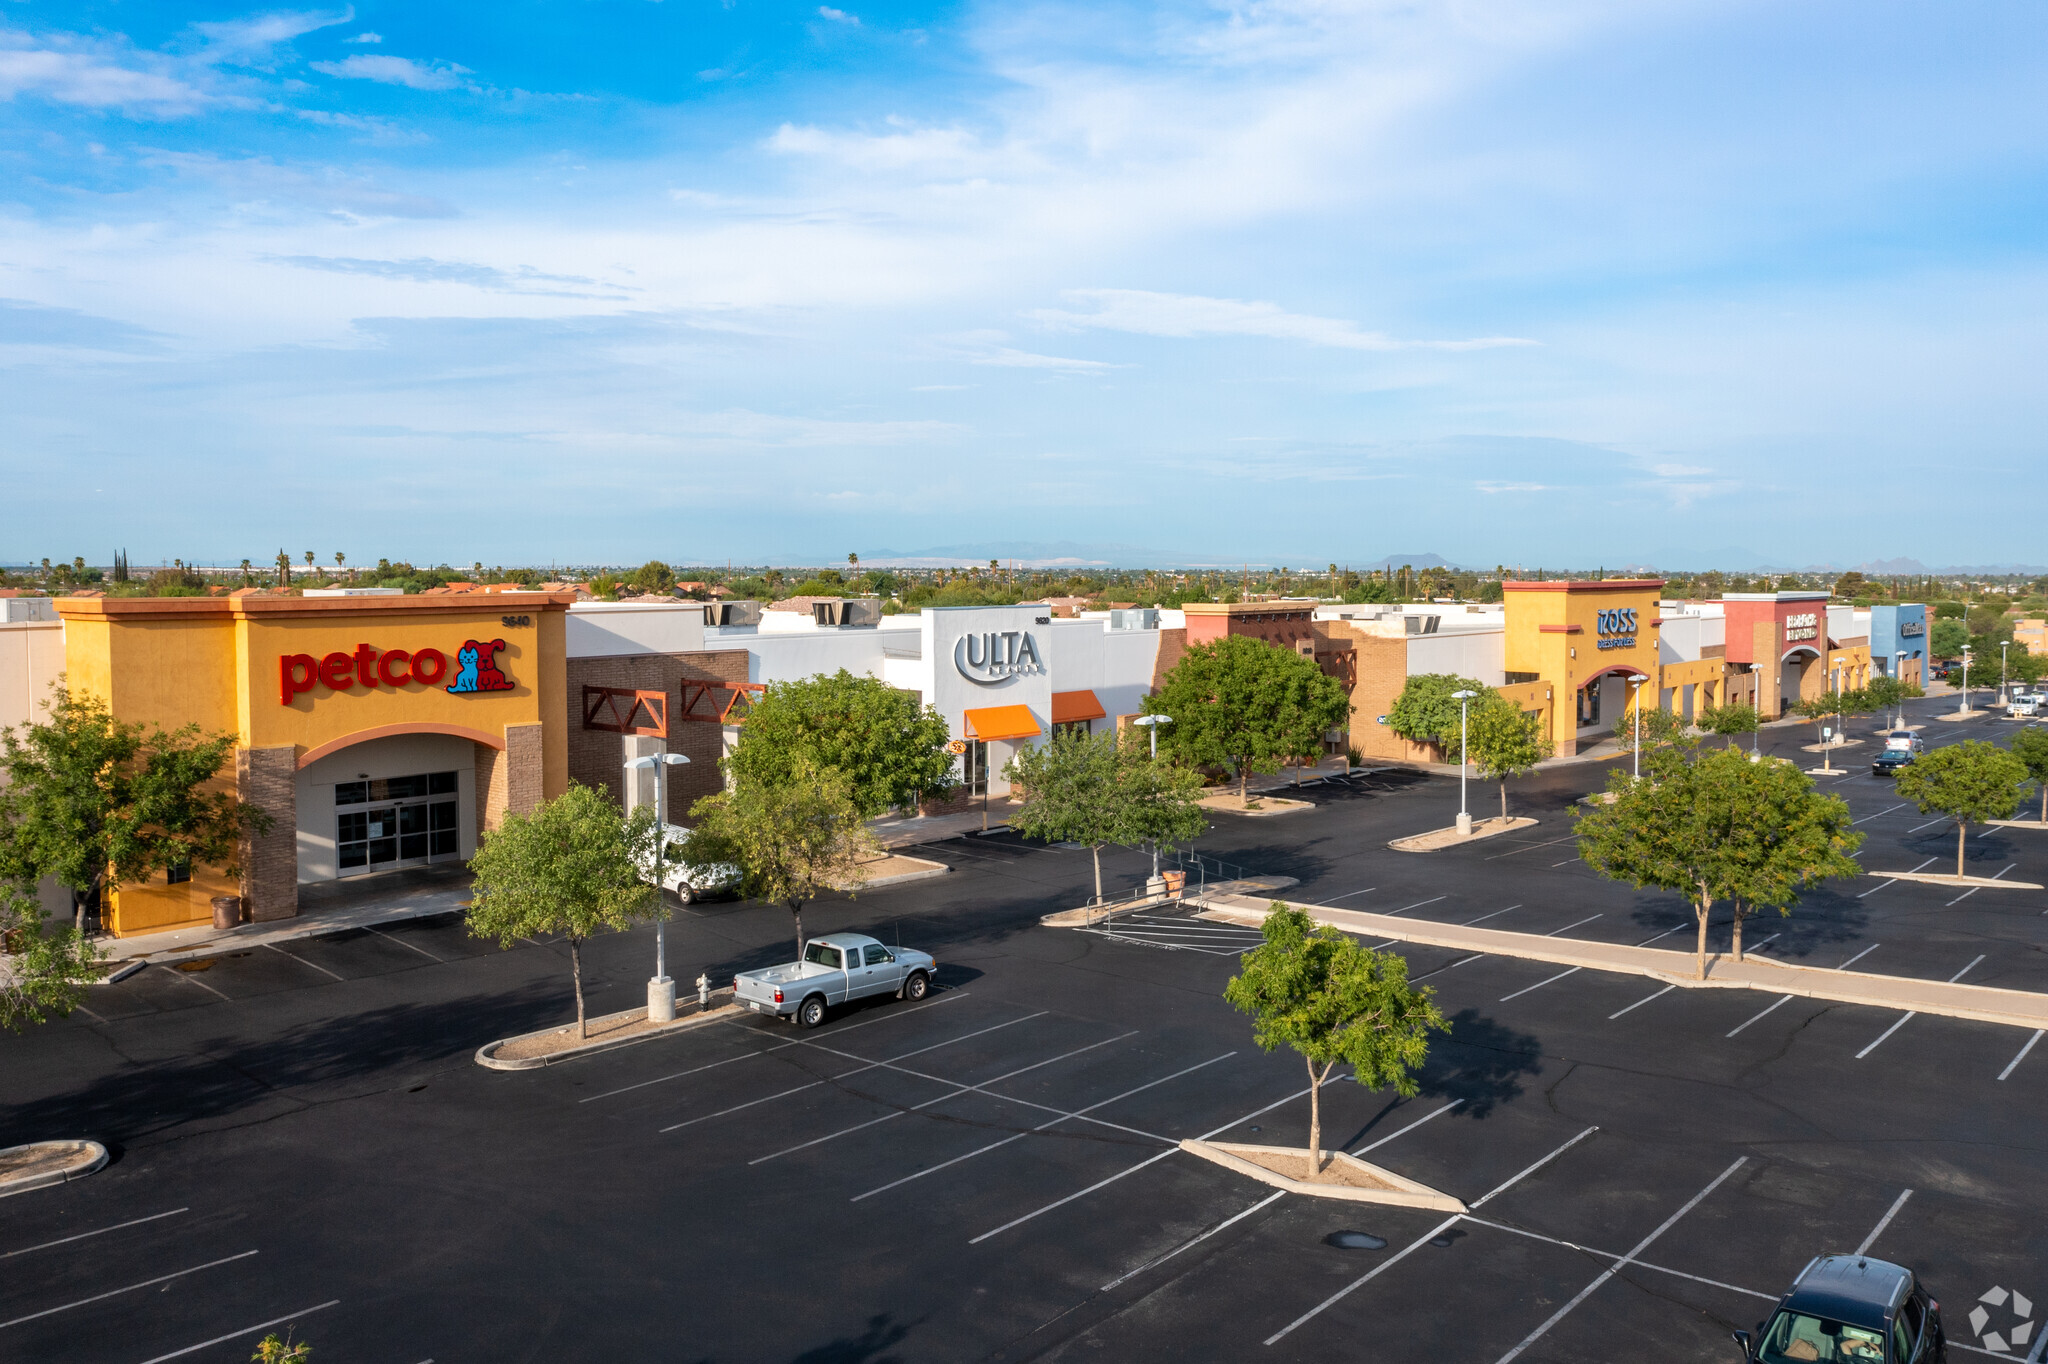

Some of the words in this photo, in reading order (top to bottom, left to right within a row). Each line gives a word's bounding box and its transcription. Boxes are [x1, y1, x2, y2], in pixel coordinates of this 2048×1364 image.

[1597, 608, 1636, 634] ROSS
[965, 631, 1036, 667] ULTA
[279, 643, 447, 706] petco
[987, 664, 1040, 675] BEAUTY
